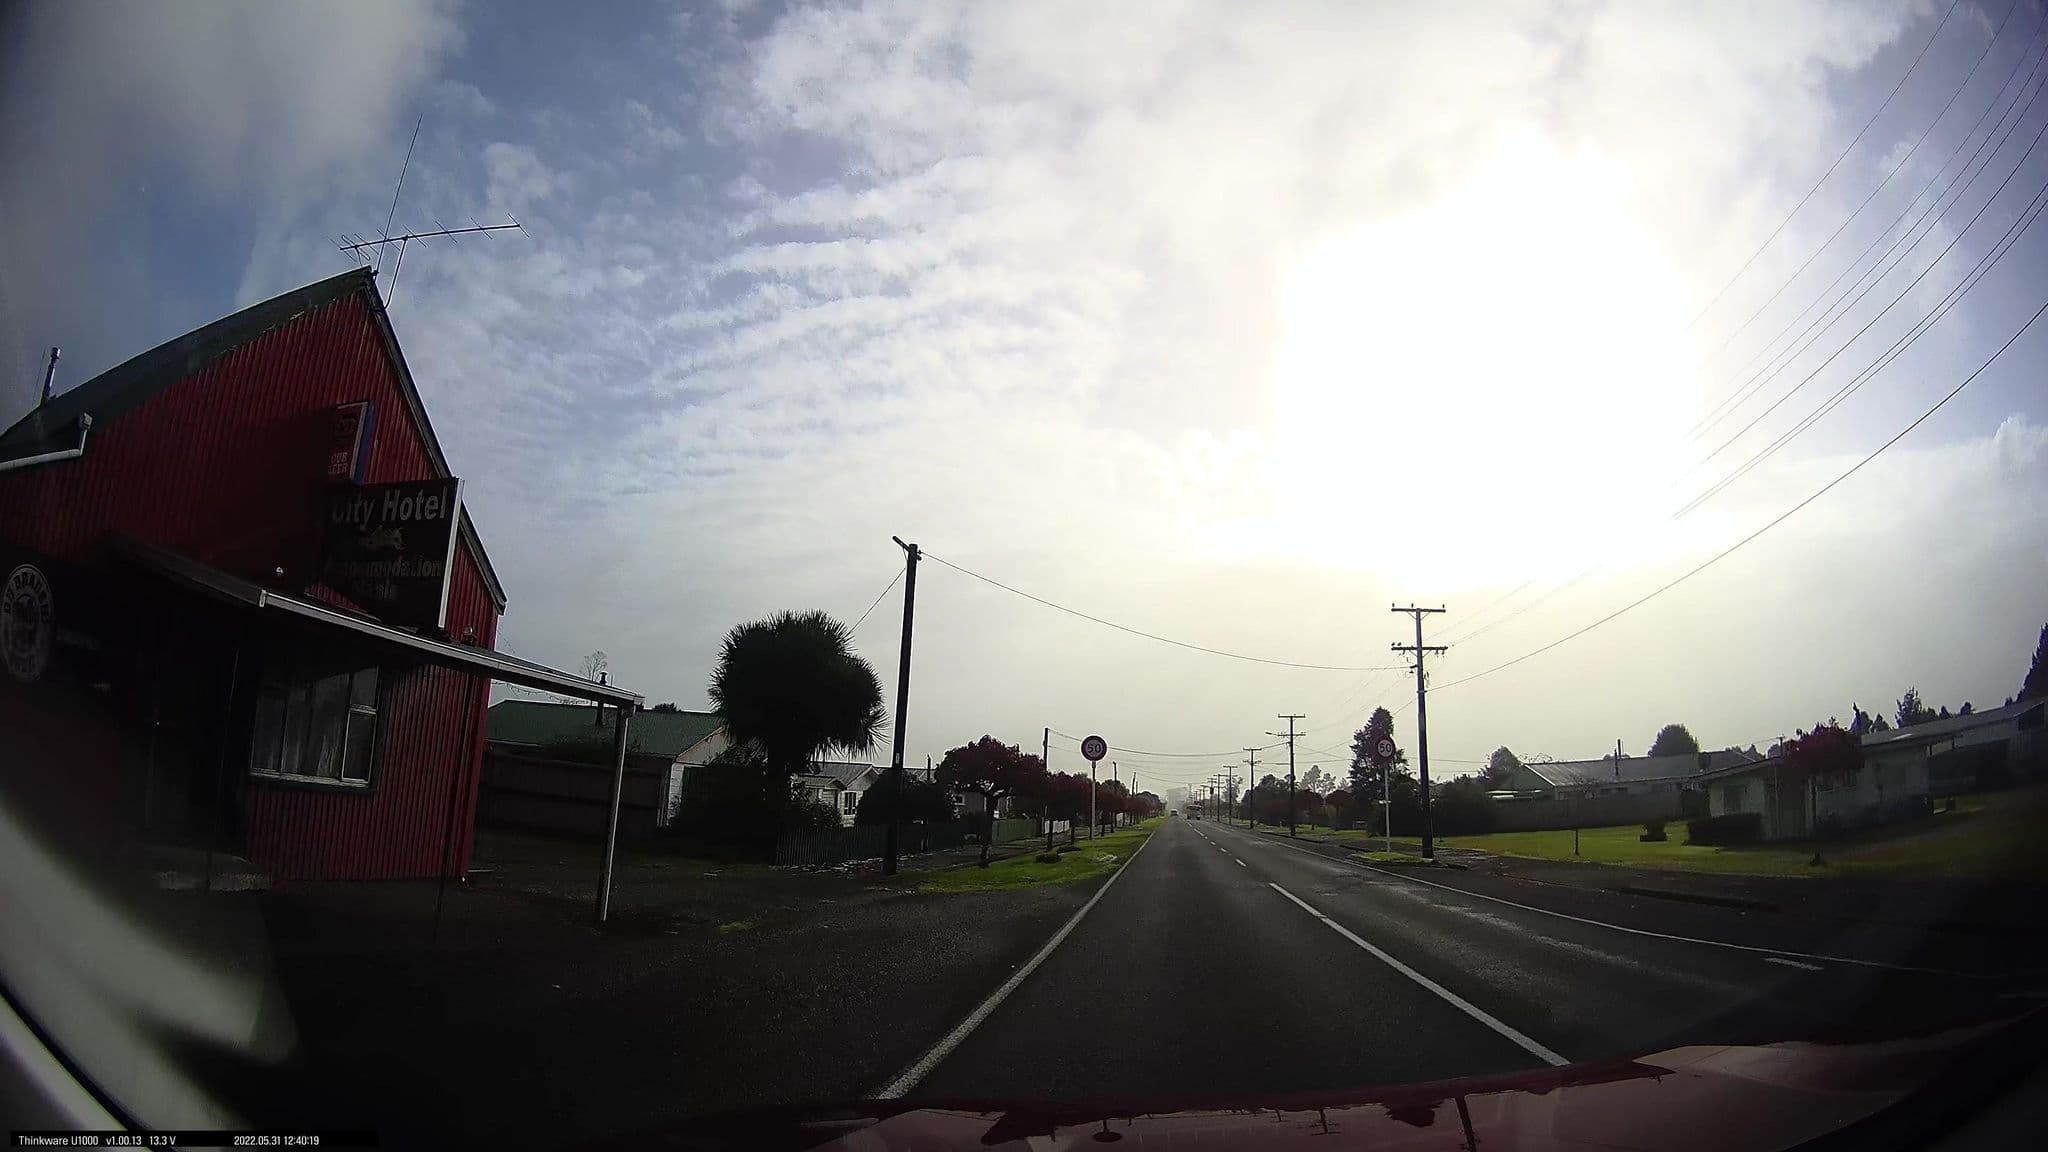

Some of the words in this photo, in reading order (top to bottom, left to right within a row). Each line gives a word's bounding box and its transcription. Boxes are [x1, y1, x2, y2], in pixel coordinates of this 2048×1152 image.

[381, 485, 448, 521] Hotel
[1087, 743, 1102, 754] 50
[1379, 743, 1392, 753] 50
